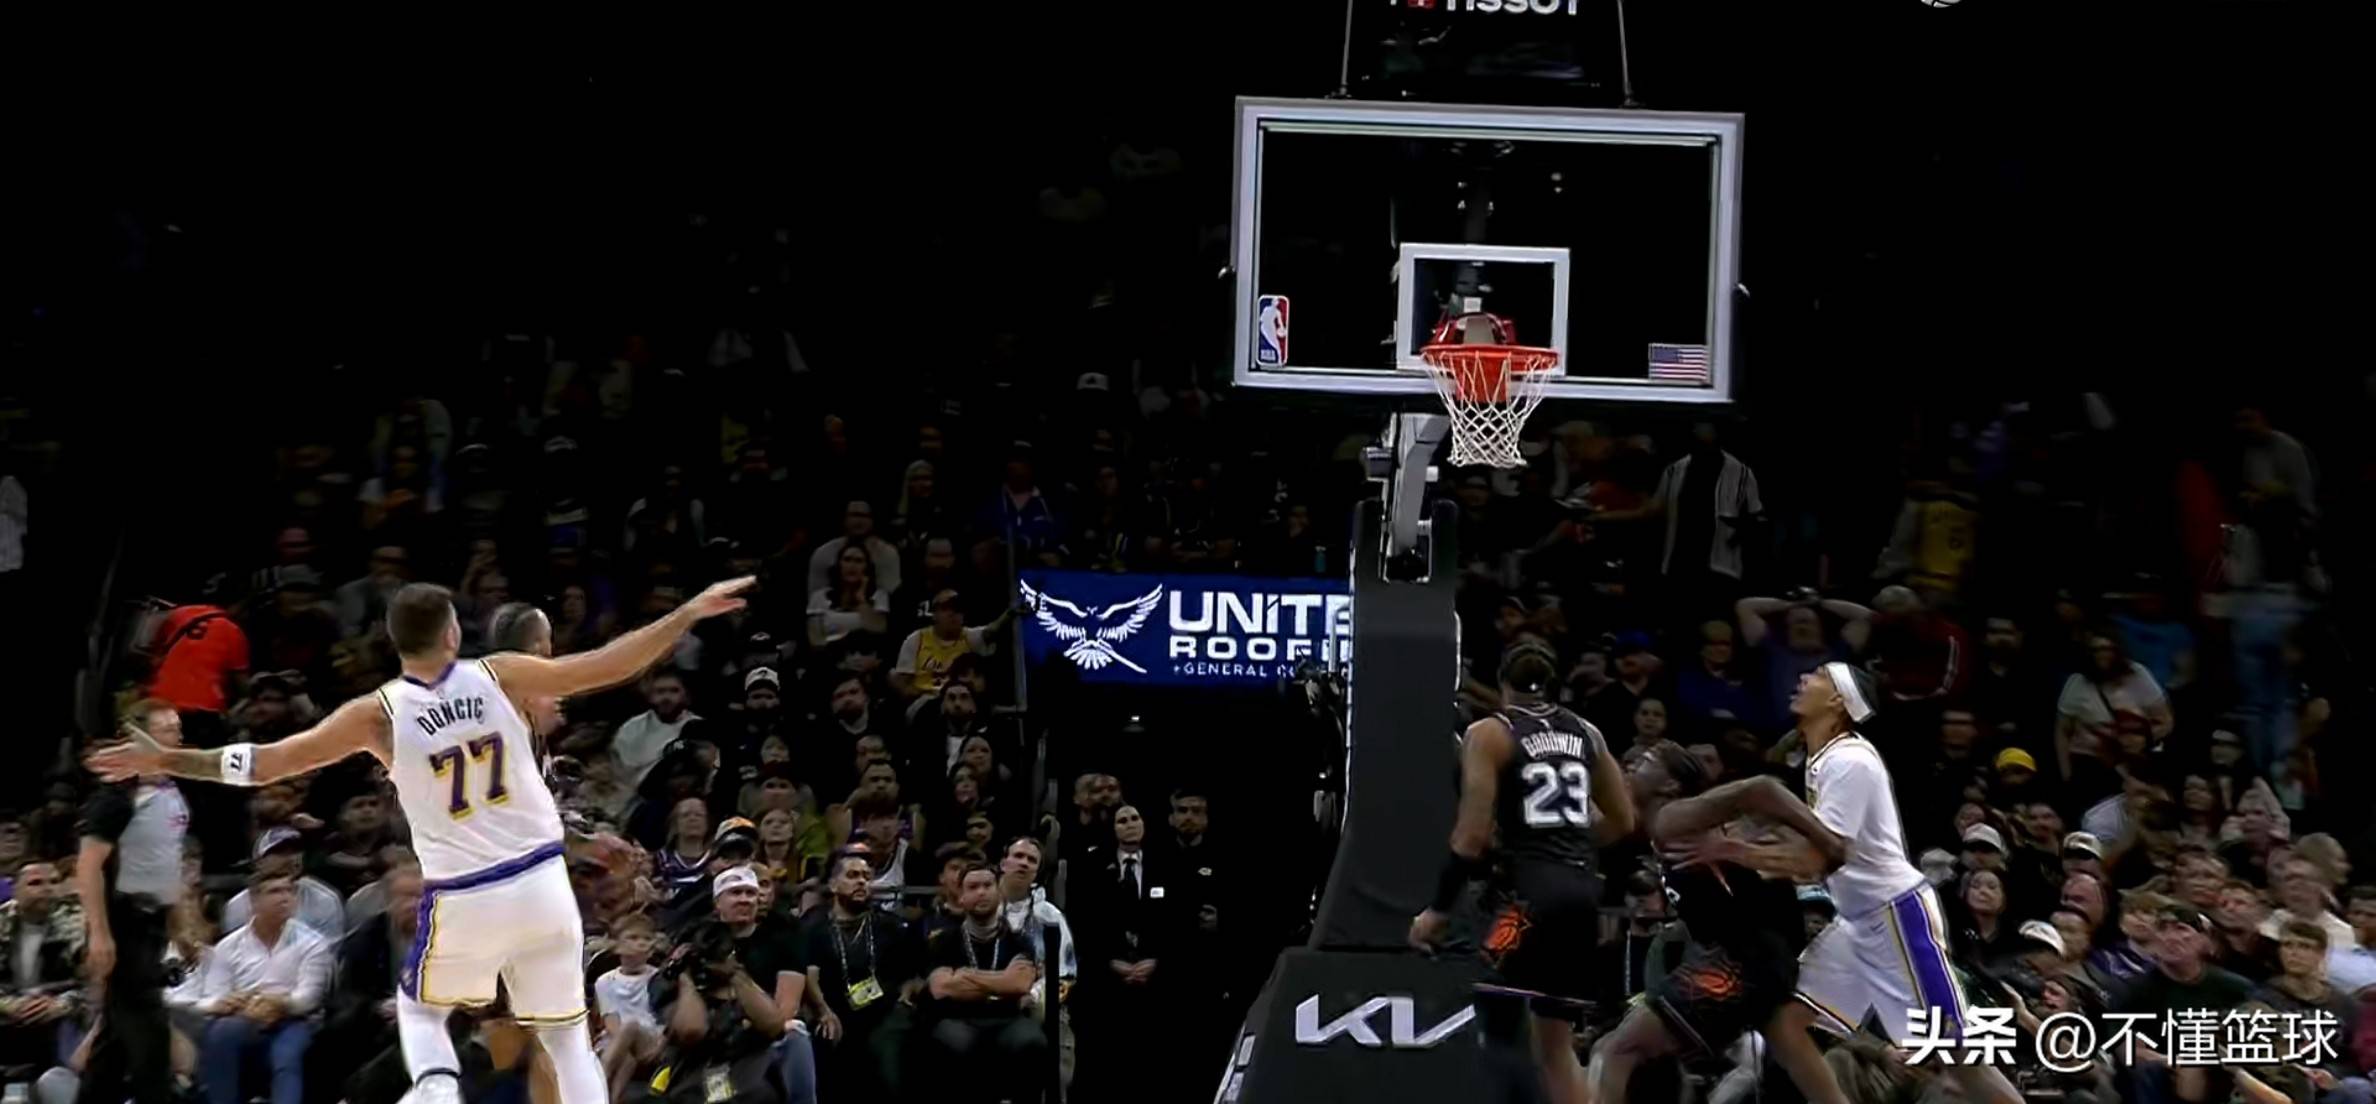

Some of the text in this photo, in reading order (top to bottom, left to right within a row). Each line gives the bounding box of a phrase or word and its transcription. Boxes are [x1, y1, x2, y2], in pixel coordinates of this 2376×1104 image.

[428, 731, 511, 822] 77
[1520, 730, 1584, 759] GOODWIN
[1521, 761, 1590, 828] 23
